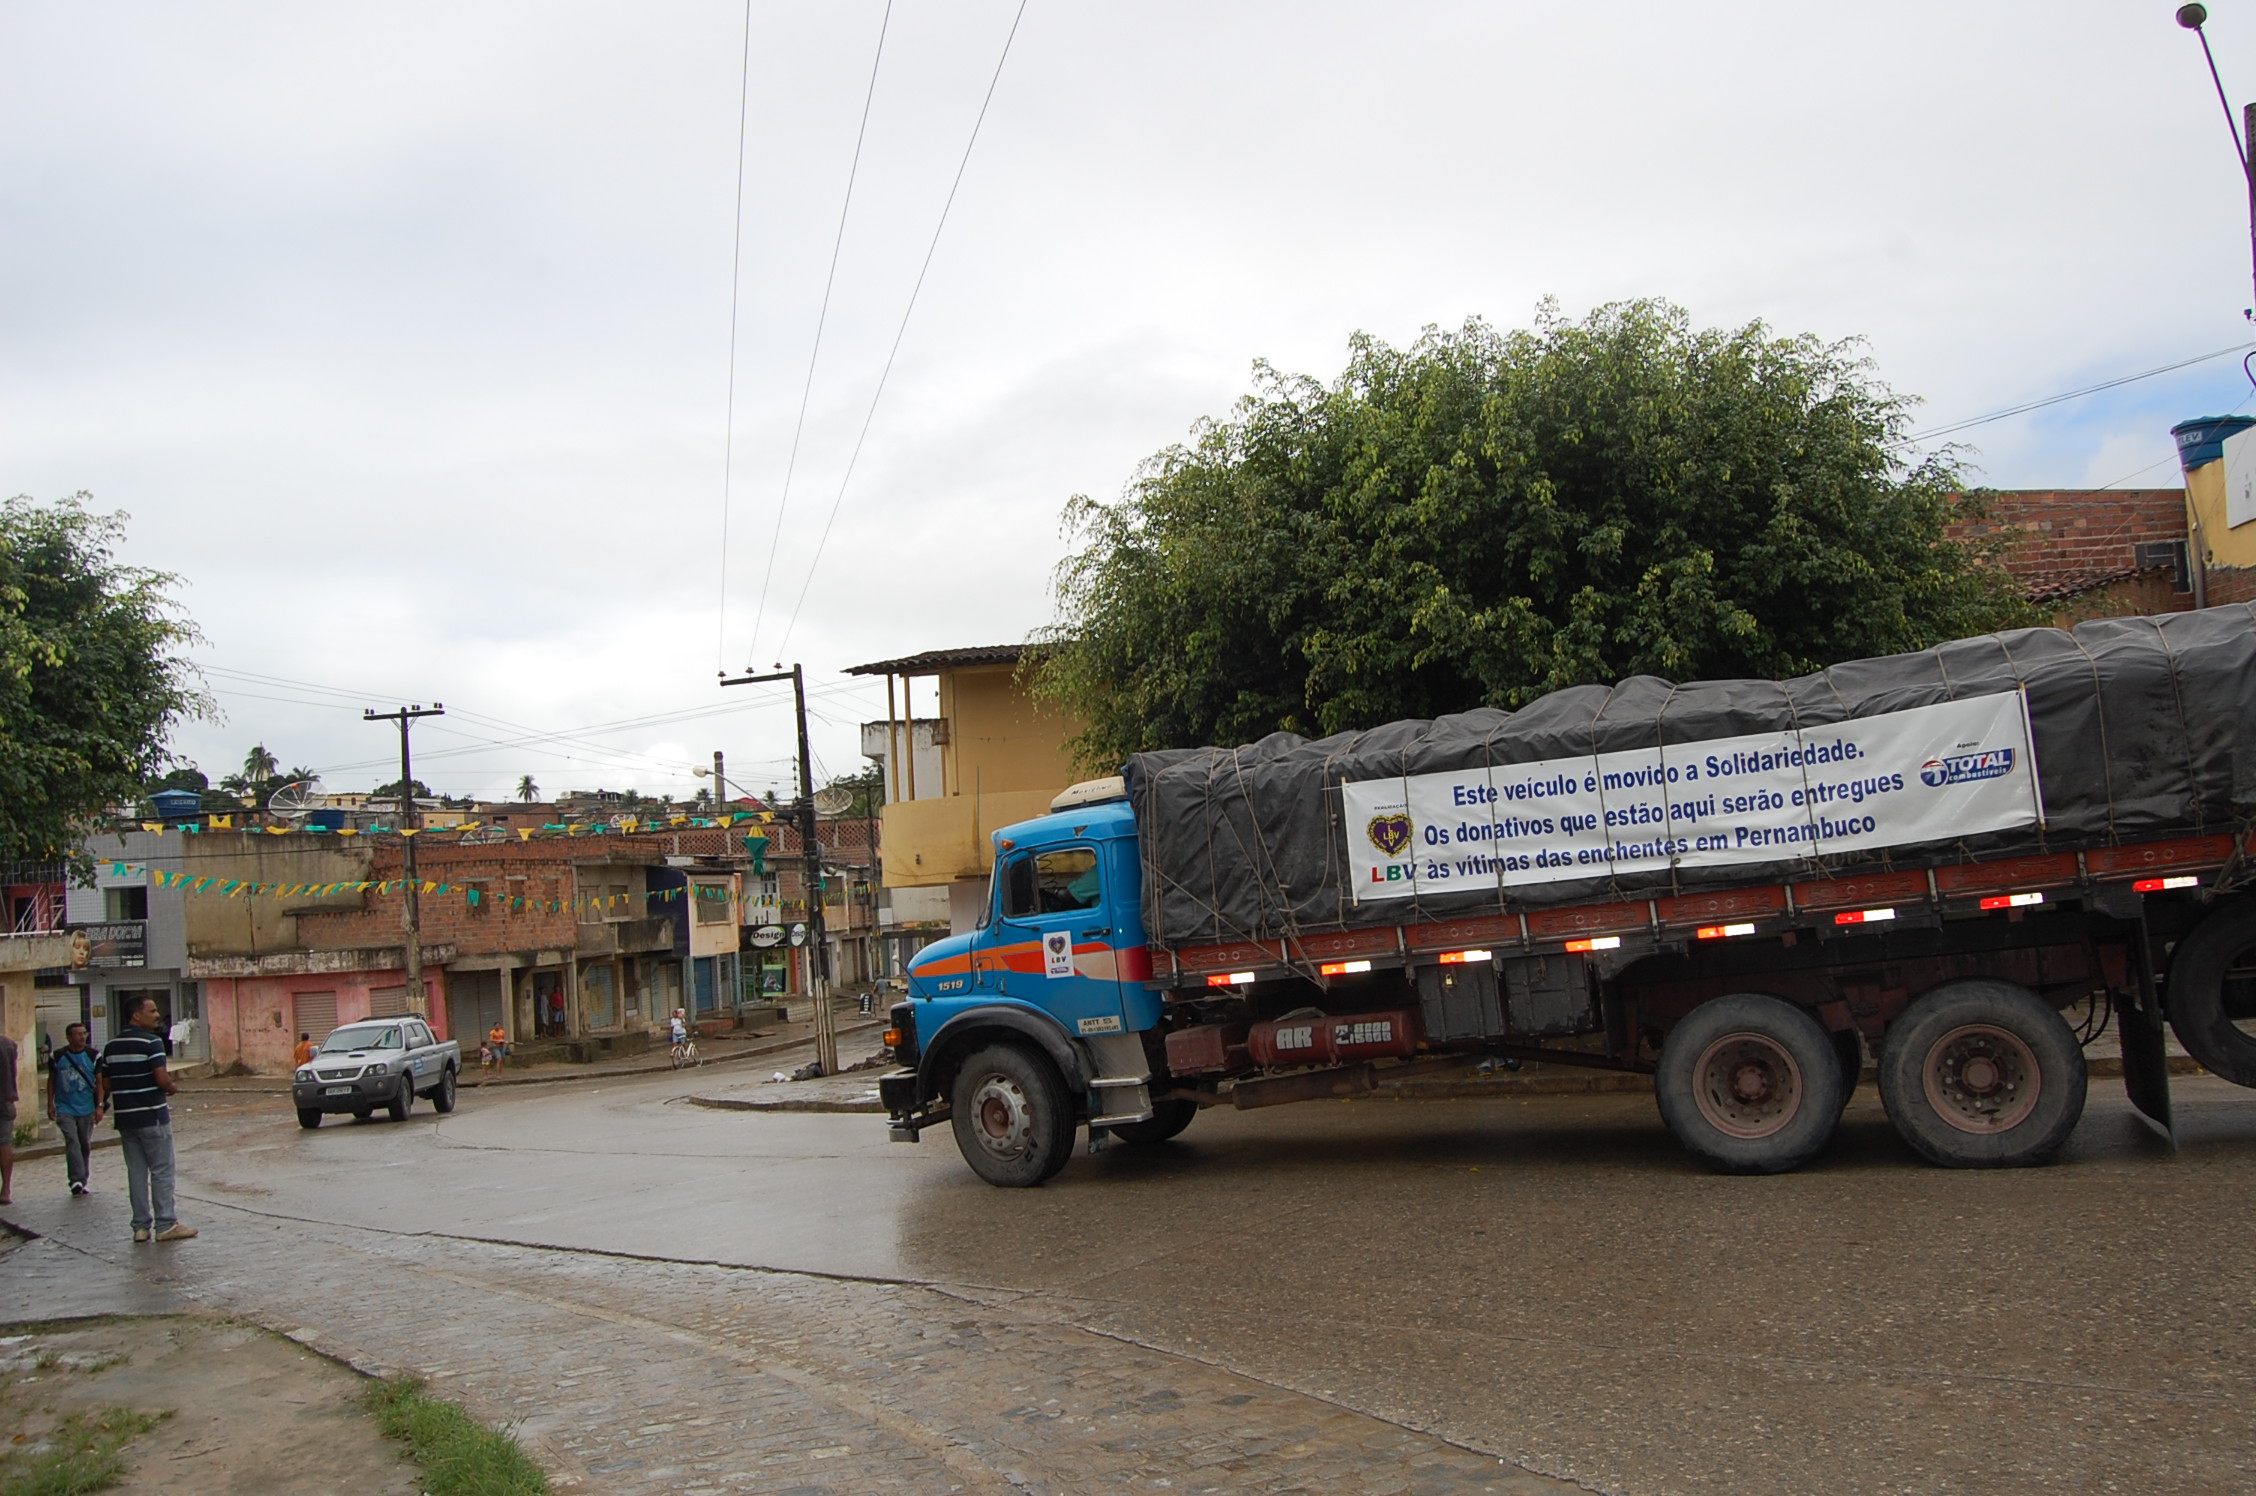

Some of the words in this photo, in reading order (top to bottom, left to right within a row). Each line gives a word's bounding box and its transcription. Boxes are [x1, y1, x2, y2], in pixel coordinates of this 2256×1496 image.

[1453, 784, 1498, 807] Este
[1503, 774, 1577, 801] veículo
[1584, 770, 1597, 793] é
[1603, 762, 1679, 791] movido
[1685, 764, 1699, 780] a
[1705, 738, 1865, 778] Solidariedade.
[1946, 751, 2010, 773] TOTAL
[1424, 824, 1450, 846] Os
[1456, 816, 1554, 843] donativos
[1560, 813, 1597, 837] que
[1604, 802, 1663, 827] estão
[1670, 794, 1715, 823] aqui
[1722, 789, 1784, 814] serão
[1791, 772, 1904, 807] entregues
[1427, 858, 1450, 880] às
[1455, 854, 1530, 877] vítimas
[1535, 848, 1573, 869] das
[1578, 837, 1688, 865] enchentes
[1696, 834, 1728, 852] em
[1735, 814, 1876, 848] Pernambuco
[1371, 863, 1418, 883] LBV
[752, 930, 785, 940] Design
[938, 979, 964, 991] 1519
[1276, 1026, 1313, 1050] AR
